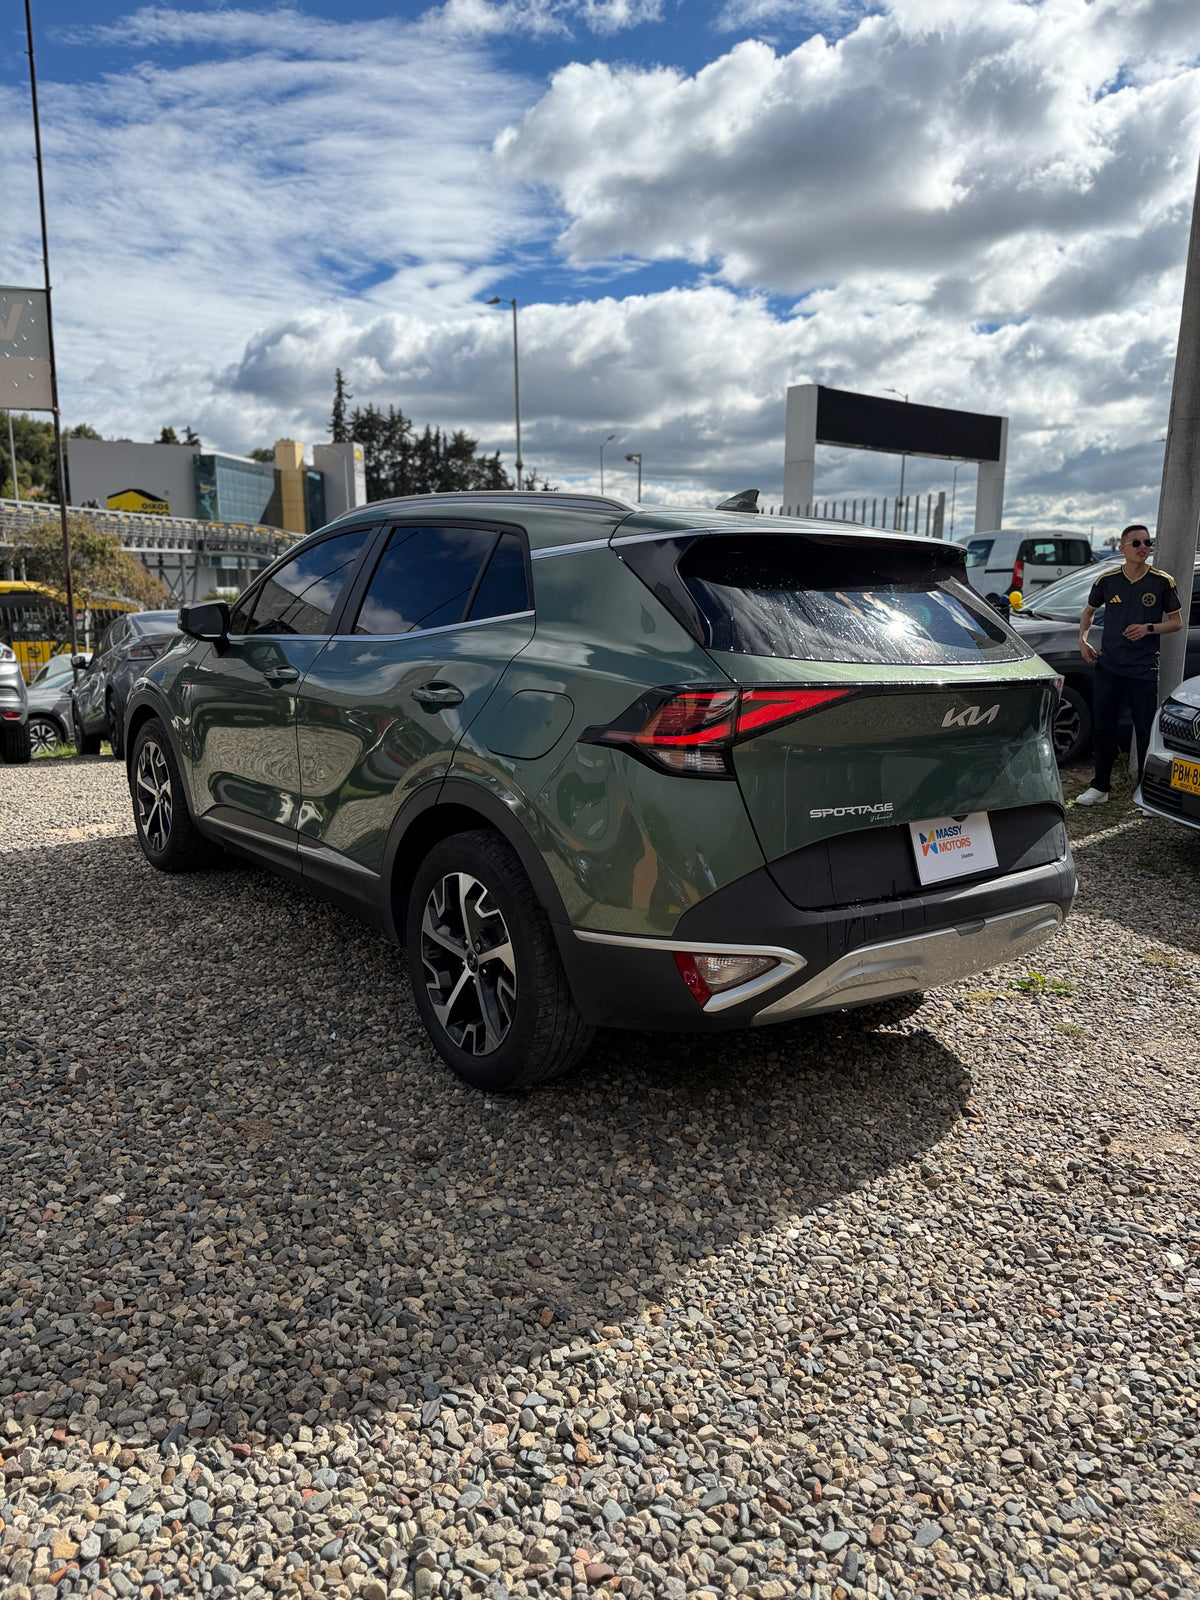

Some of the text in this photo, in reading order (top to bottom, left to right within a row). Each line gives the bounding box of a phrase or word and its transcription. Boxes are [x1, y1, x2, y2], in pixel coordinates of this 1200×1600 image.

[941, 704, 1000, 727] KIA
[809, 803, 894, 818] SPORTAGE
[935, 825, 962, 839] MASSY
[938, 837, 971, 853] MOTORS
